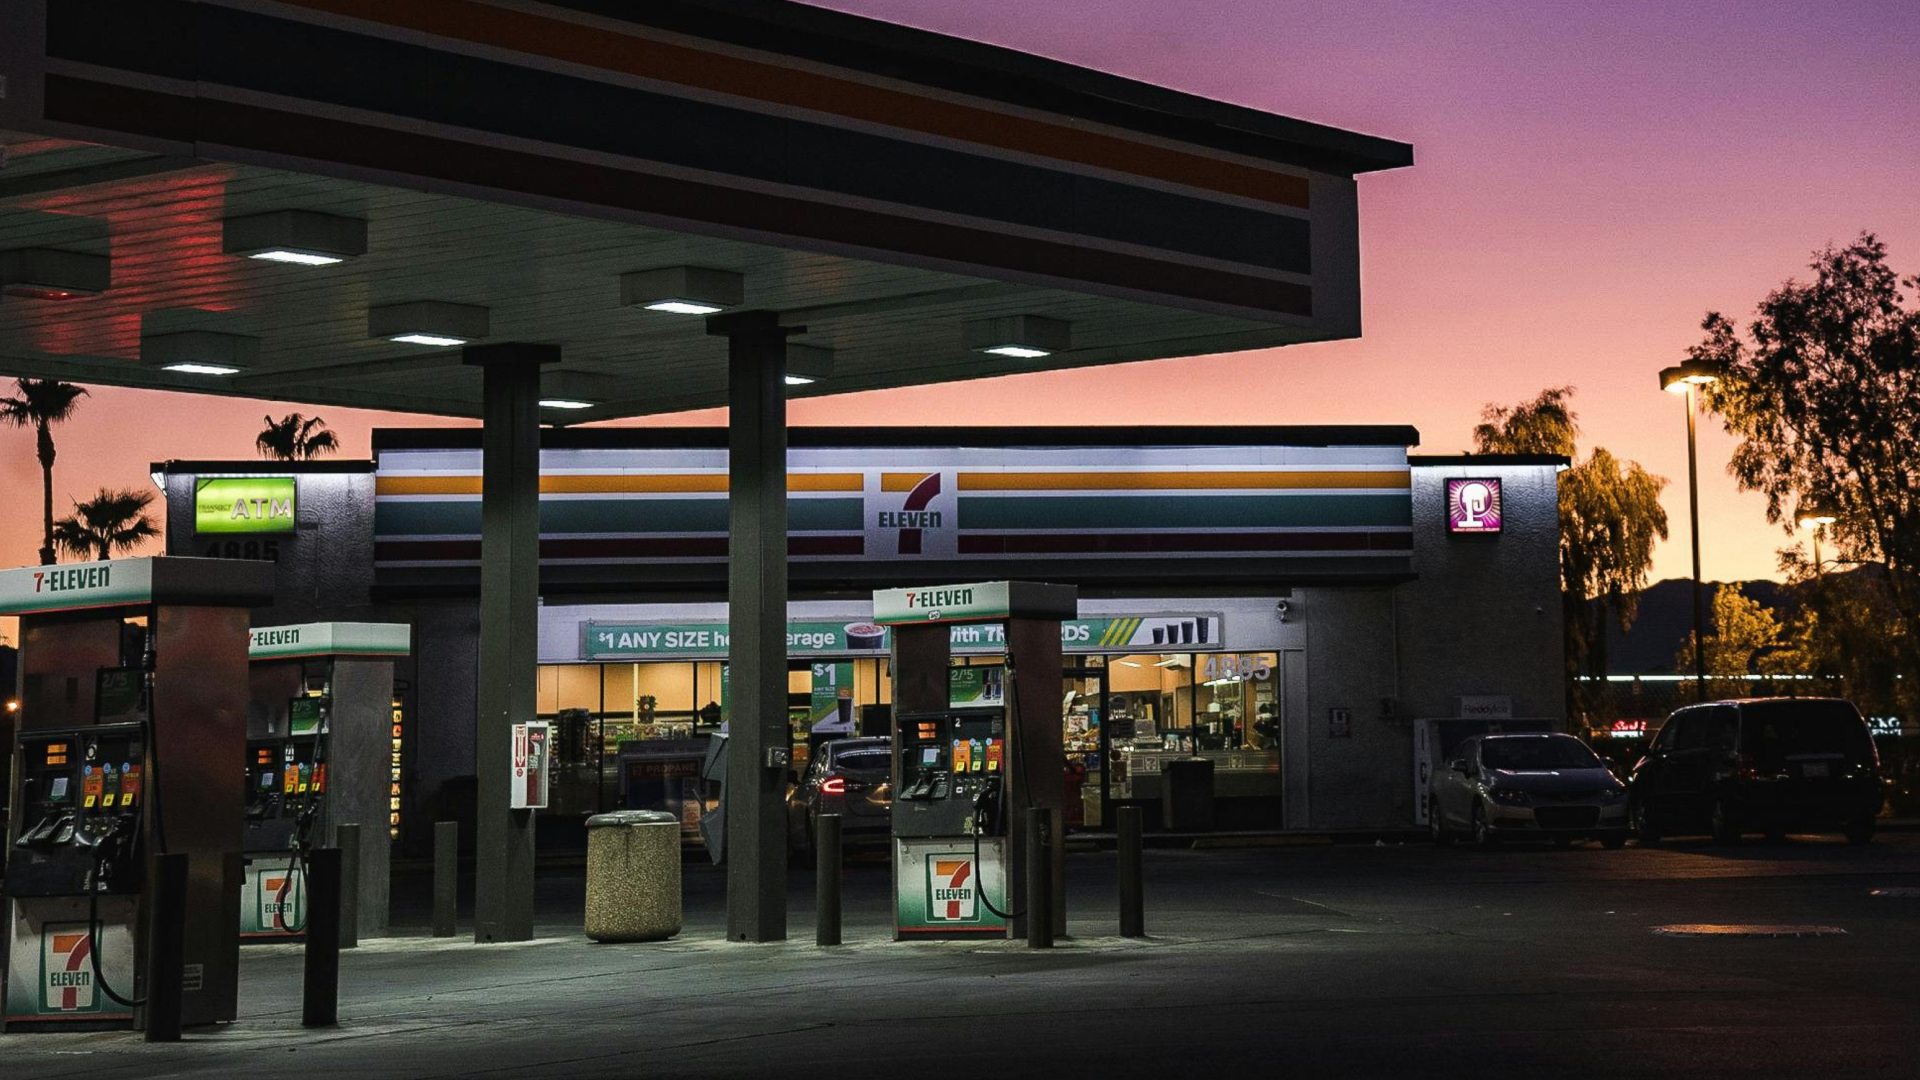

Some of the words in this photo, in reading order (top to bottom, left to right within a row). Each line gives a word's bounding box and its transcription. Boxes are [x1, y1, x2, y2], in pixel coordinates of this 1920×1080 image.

[231, 498, 292, 519] ATM
[599, 632, 613, 648] $1
[617, 632, 661, 648] ANY
[665, 630, 709, 647] SIZE
[786, 632, 835, 649] erage
[814, 664, 836, 685] $1
[955, 718, 961, 728] 2
[646, 763, 696, 773] PROPANE
